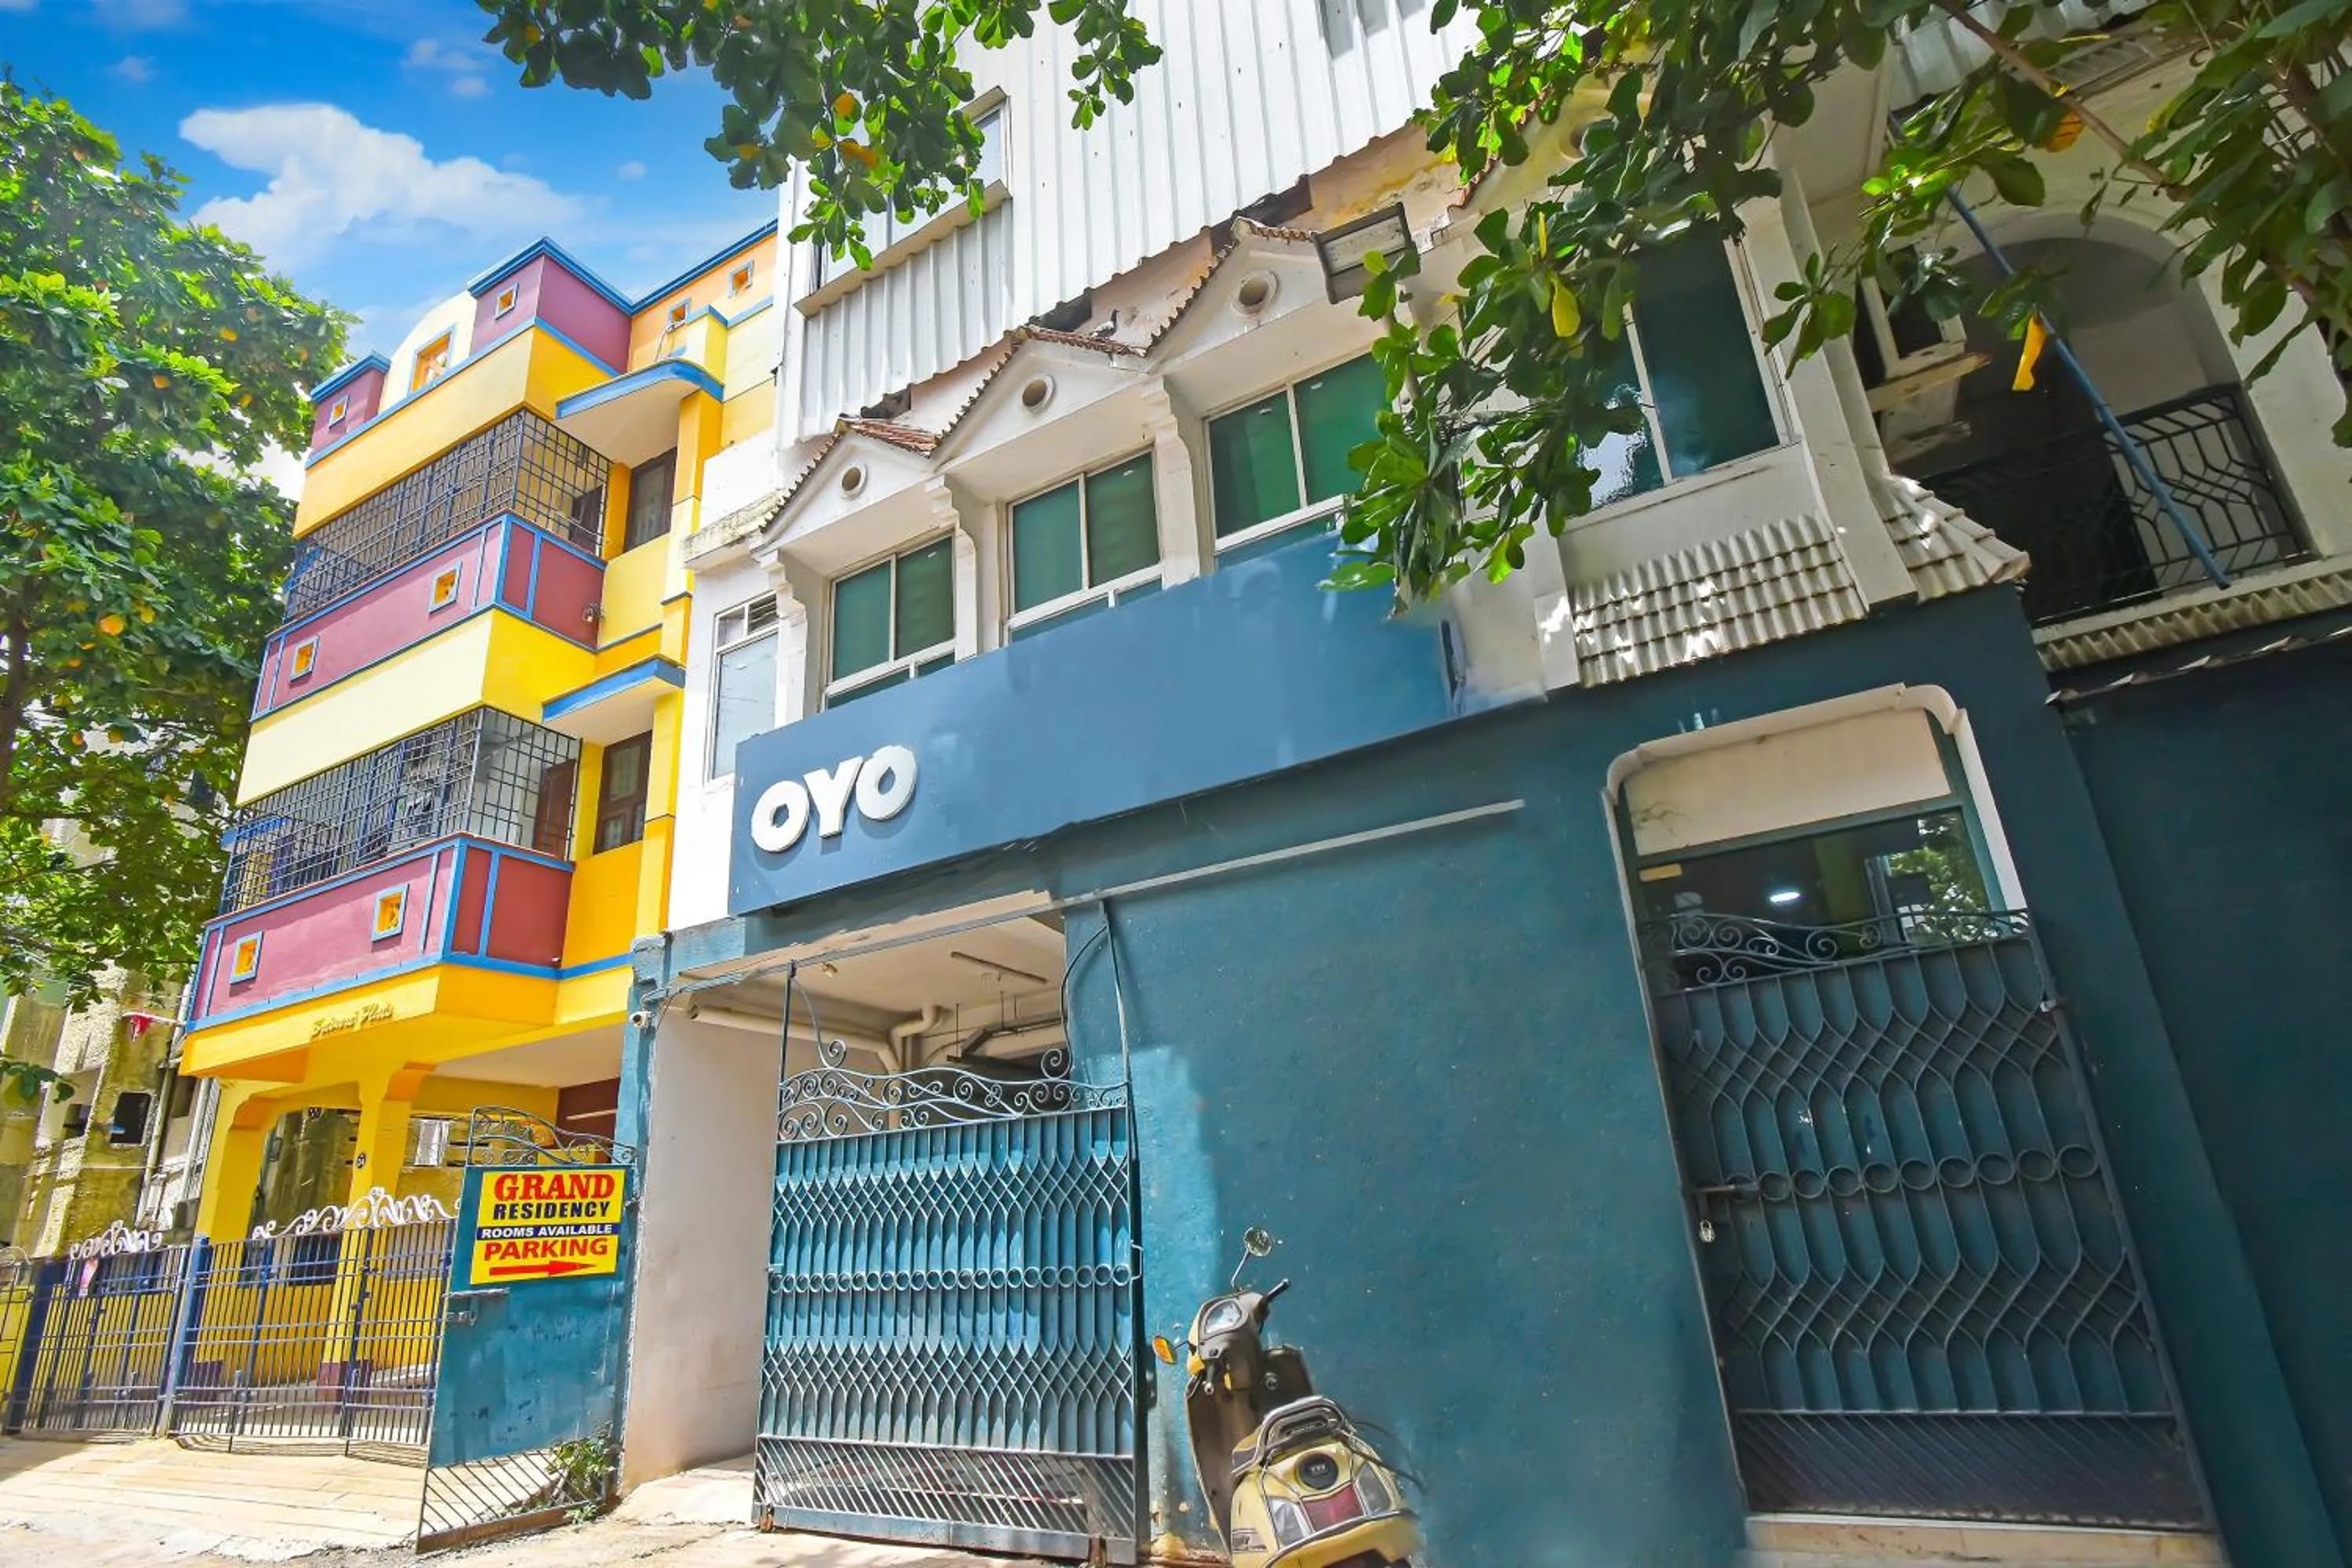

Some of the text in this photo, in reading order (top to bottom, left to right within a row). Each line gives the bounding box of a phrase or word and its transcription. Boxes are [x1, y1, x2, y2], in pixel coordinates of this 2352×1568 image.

[750, 745, 916, 852] OYO
[494, 1174, 615, 1201] GRAND
[493, 1201, 610, 1220] RESIDENCY
[481, 1224, 612, 1239] ROOMS AVAILABLE
[485, 1238, 608, 1261] PARKING
